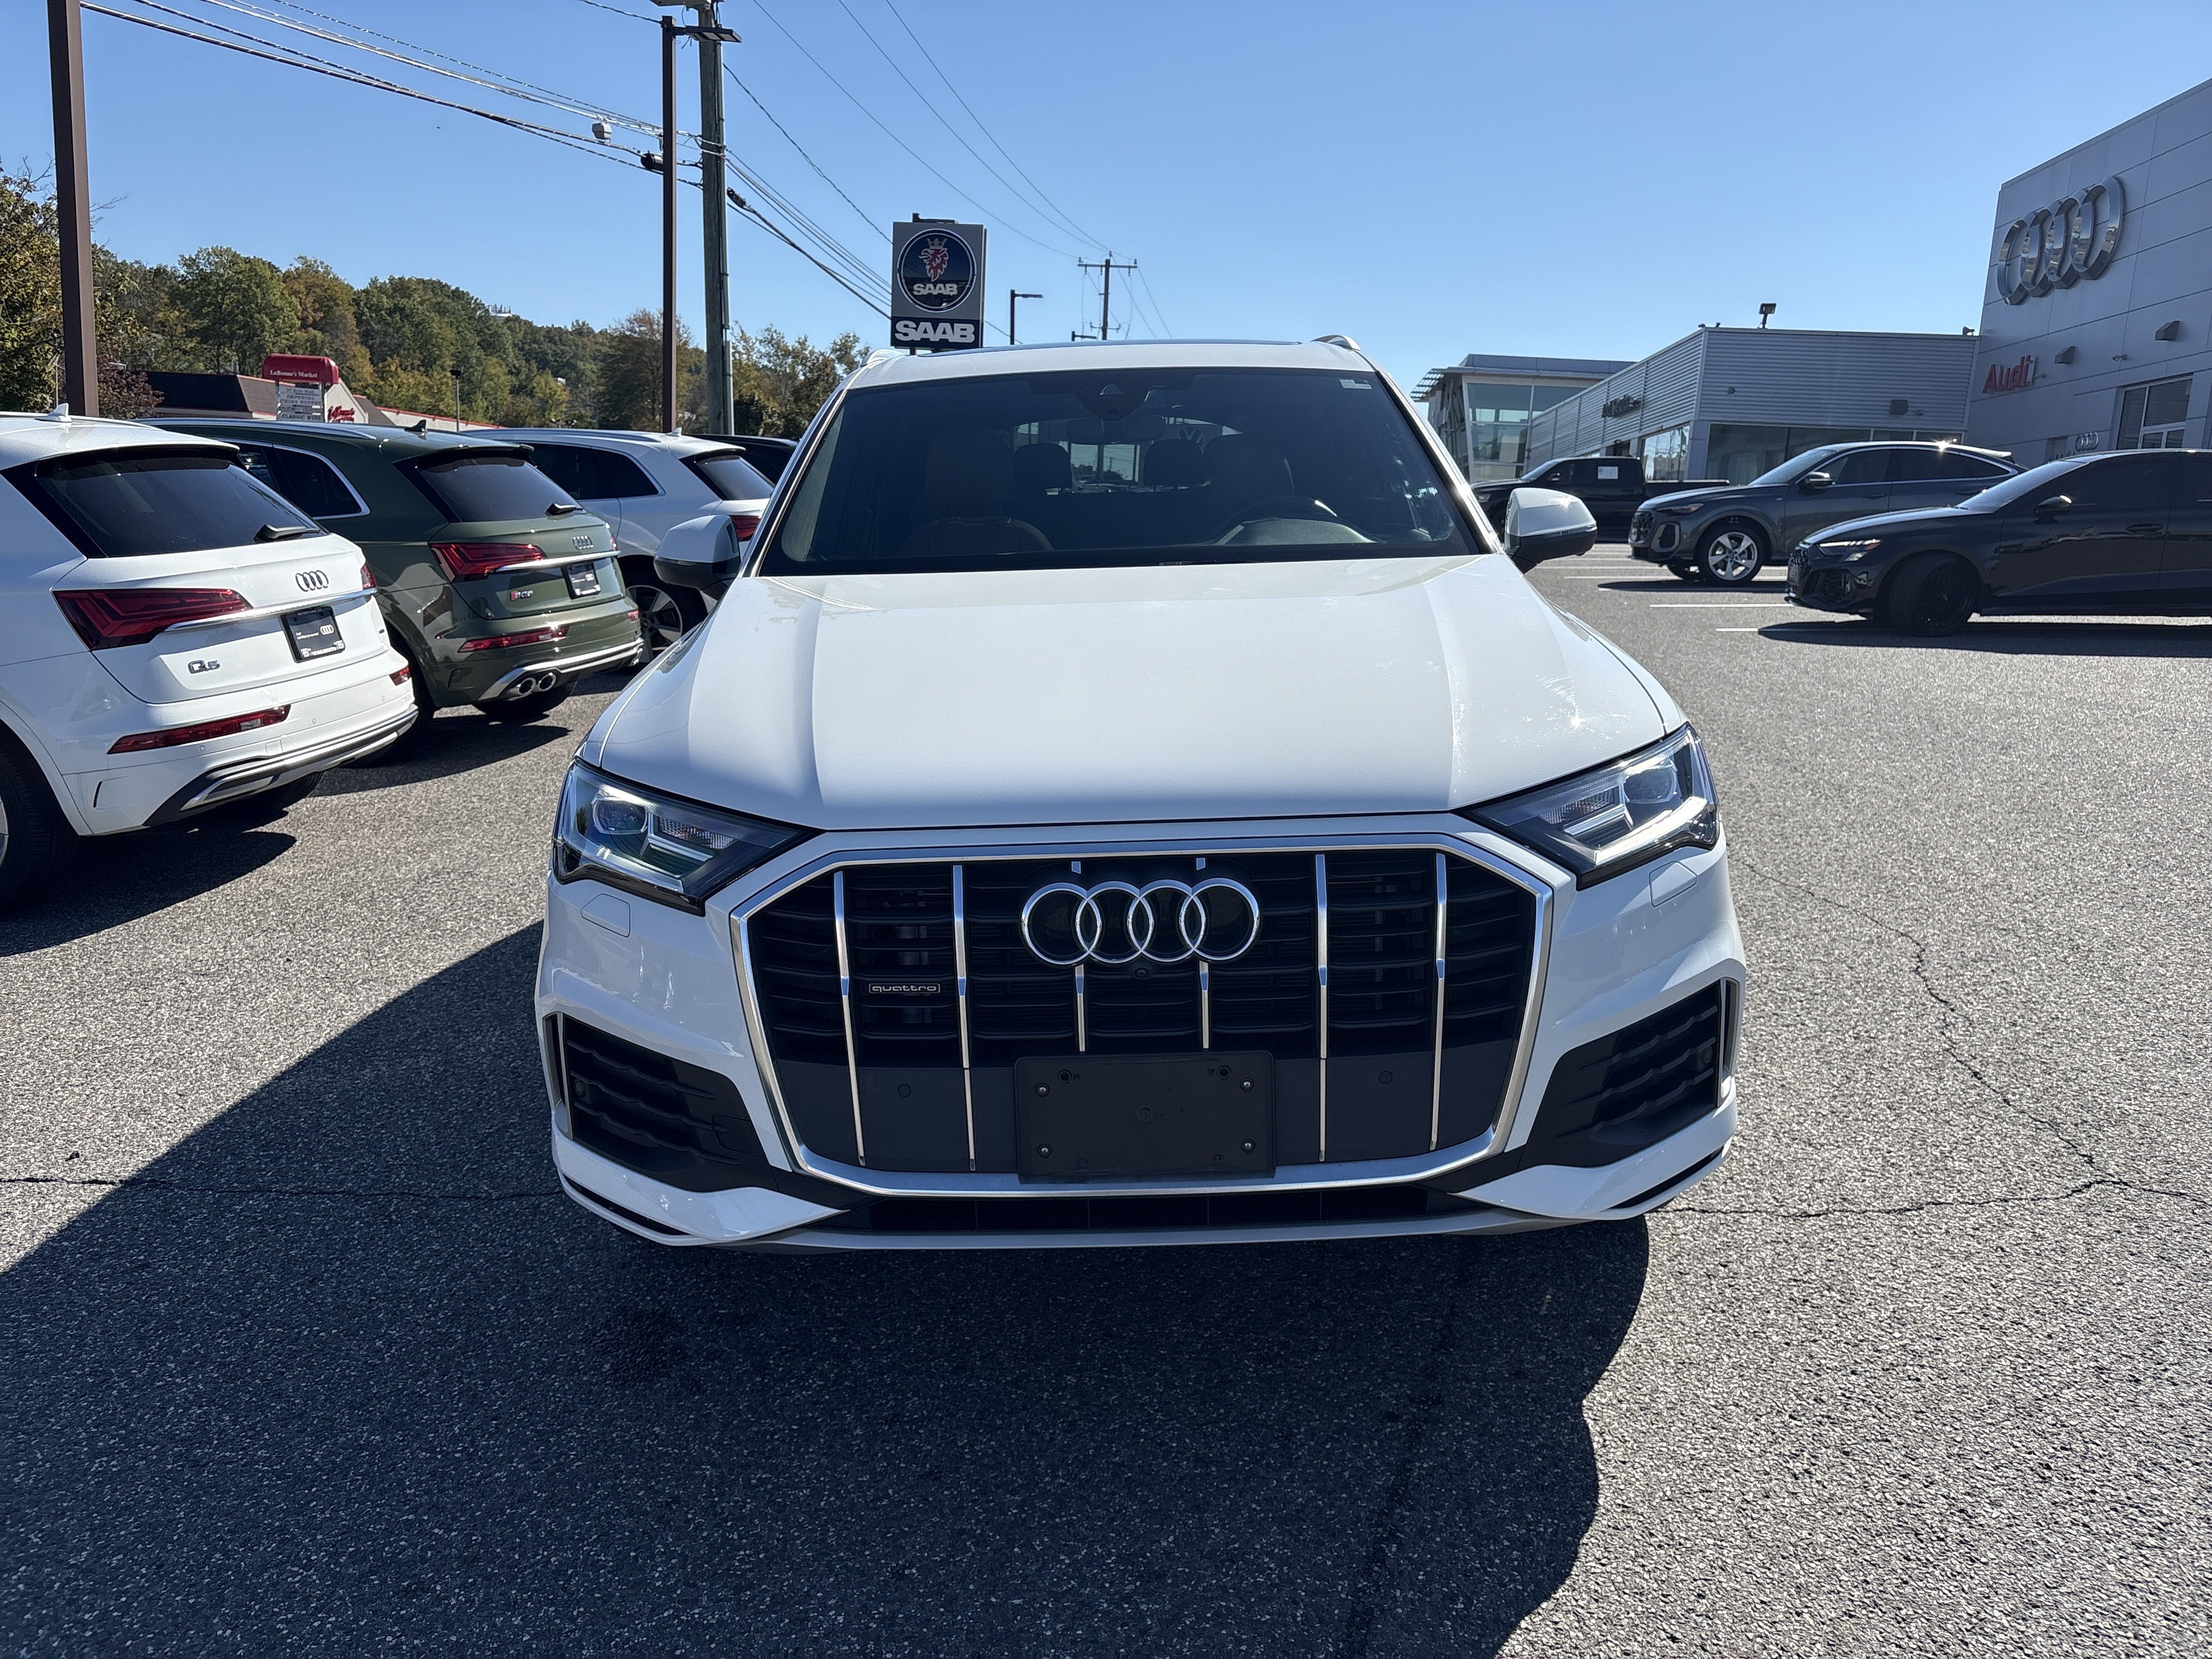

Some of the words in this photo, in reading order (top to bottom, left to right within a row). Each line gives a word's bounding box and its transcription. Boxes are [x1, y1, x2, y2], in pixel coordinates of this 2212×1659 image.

[912, 283, 958, 296] SAAB
[894, 320, 975, 343] SAAB
[1982, 354, 2033, 394] Audi
[188, 659, 220, 674] Q5
